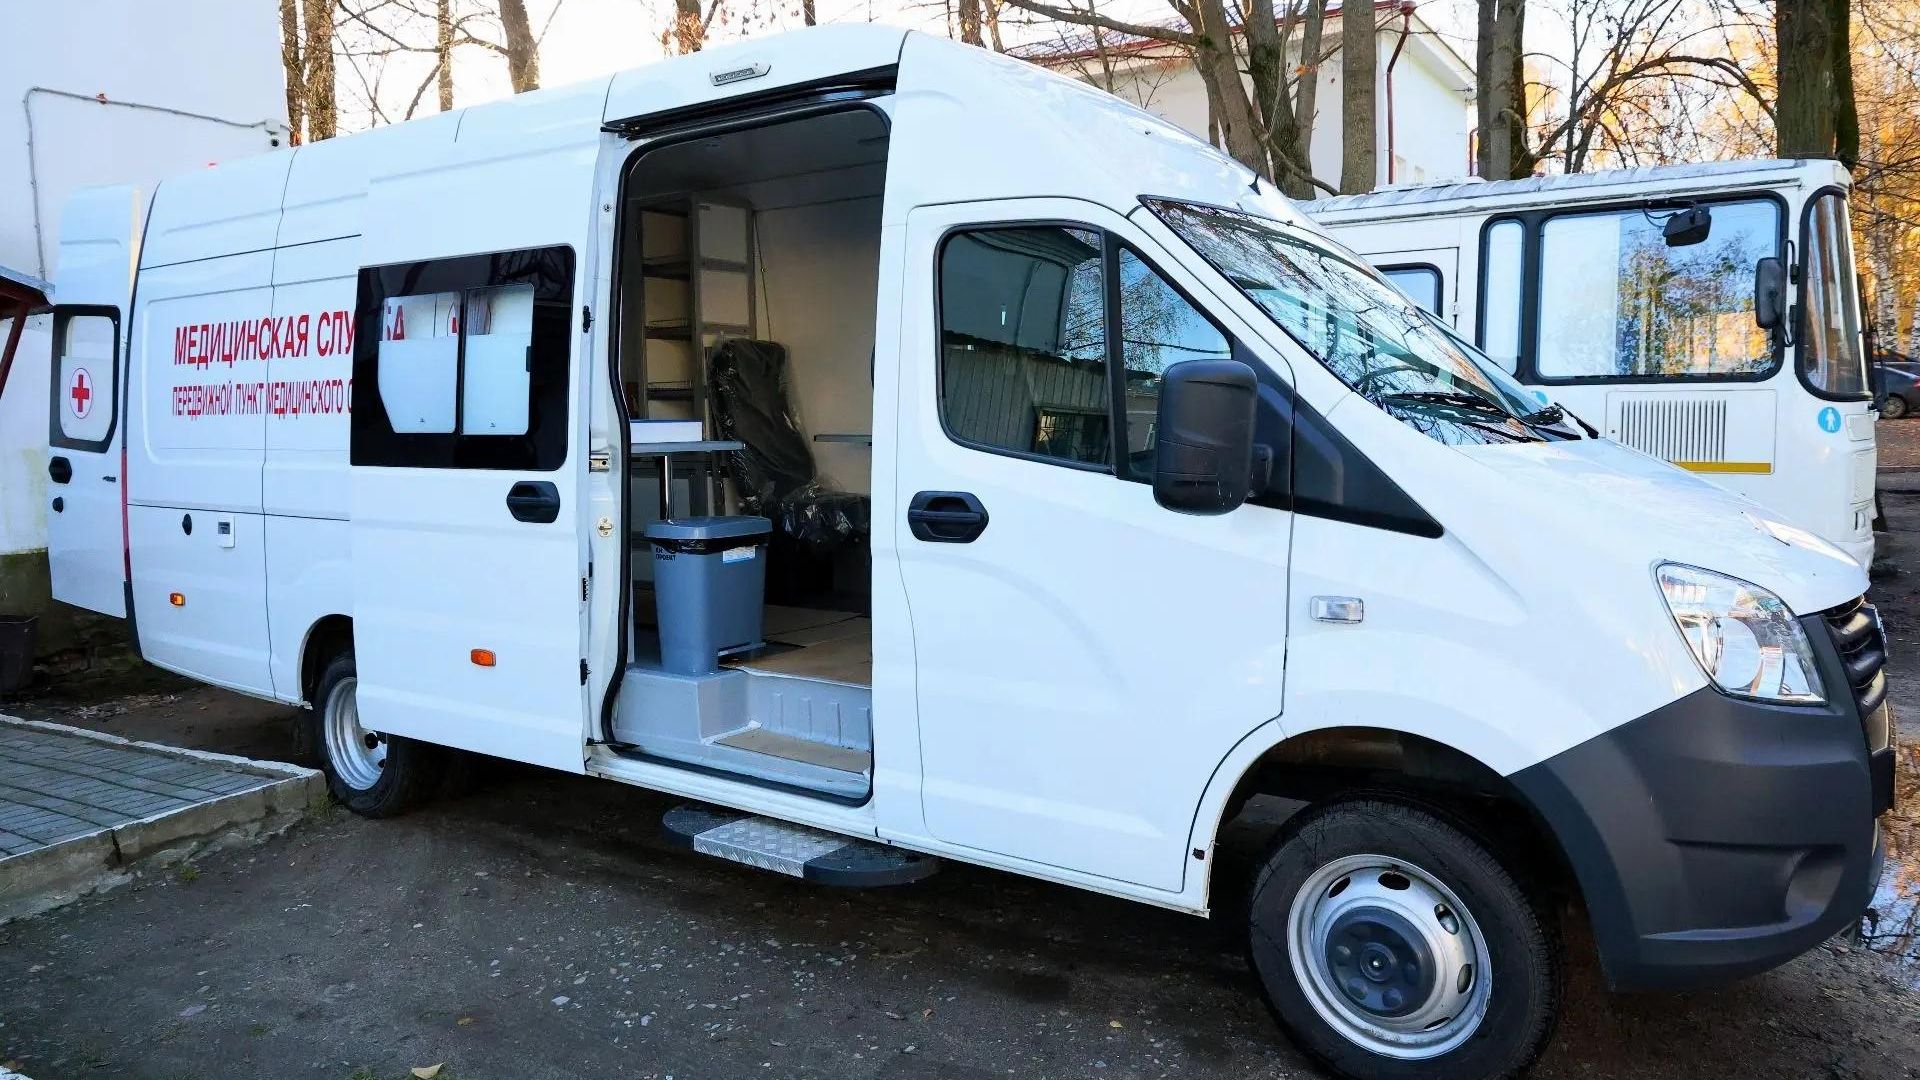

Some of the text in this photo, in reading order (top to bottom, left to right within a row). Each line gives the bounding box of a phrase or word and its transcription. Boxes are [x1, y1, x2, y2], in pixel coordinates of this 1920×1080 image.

[174, 314, 309, 370] МЕДИЦИНСКАЯ
[172, 381, 233, 420] ПЕРЕДВИЖНОЙ
[235, 382, 264, 415] ПУНКТ
[266, 379, 344, 420] МЕДИЦИНСКОГО
